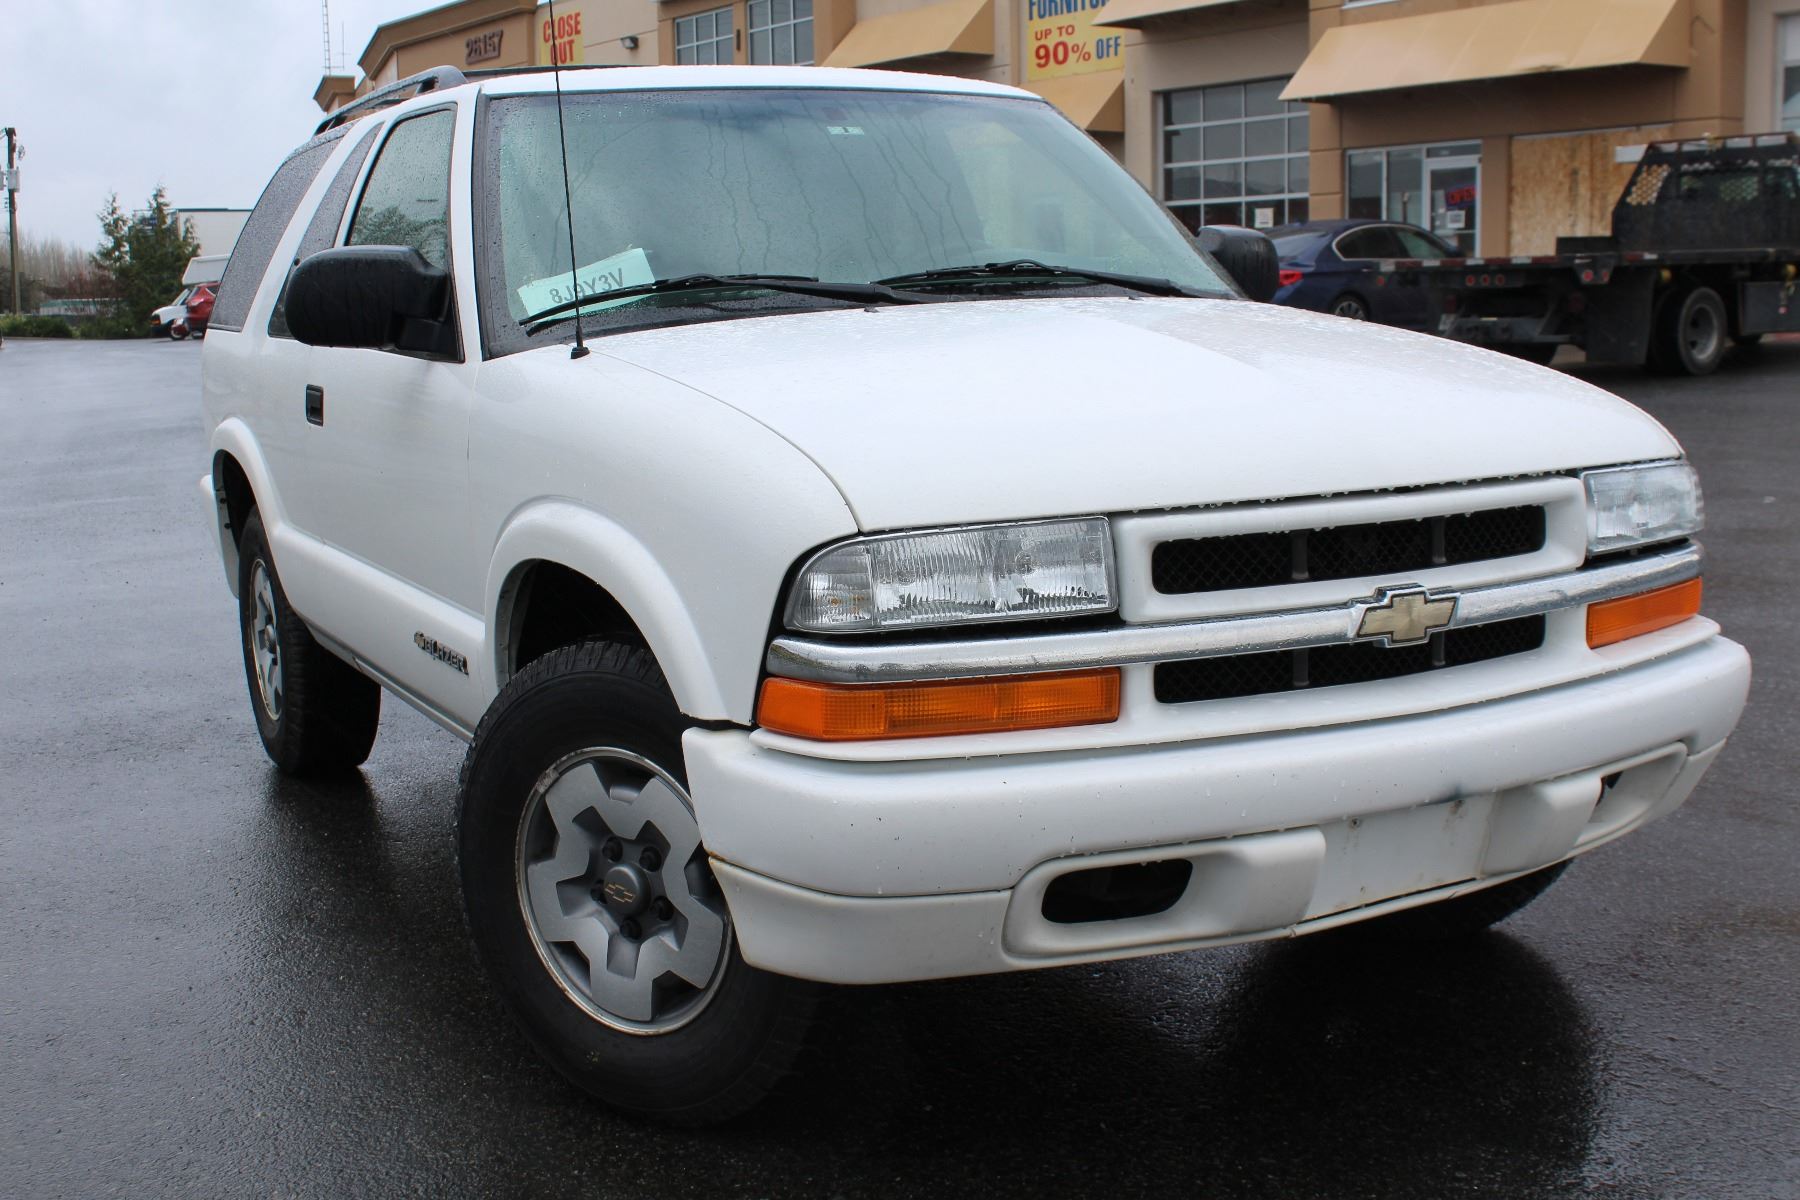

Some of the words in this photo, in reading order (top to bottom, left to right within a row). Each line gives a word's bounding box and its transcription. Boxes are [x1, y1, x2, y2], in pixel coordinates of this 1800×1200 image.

[1035, 28, 1052, 41] UP
[1057, 24, 1075, 37] TO
[551, 39, 576, 65] OUT
[1035, 41, 1092, 69] 90%
[1096, 36, 1122, 60] OFF
